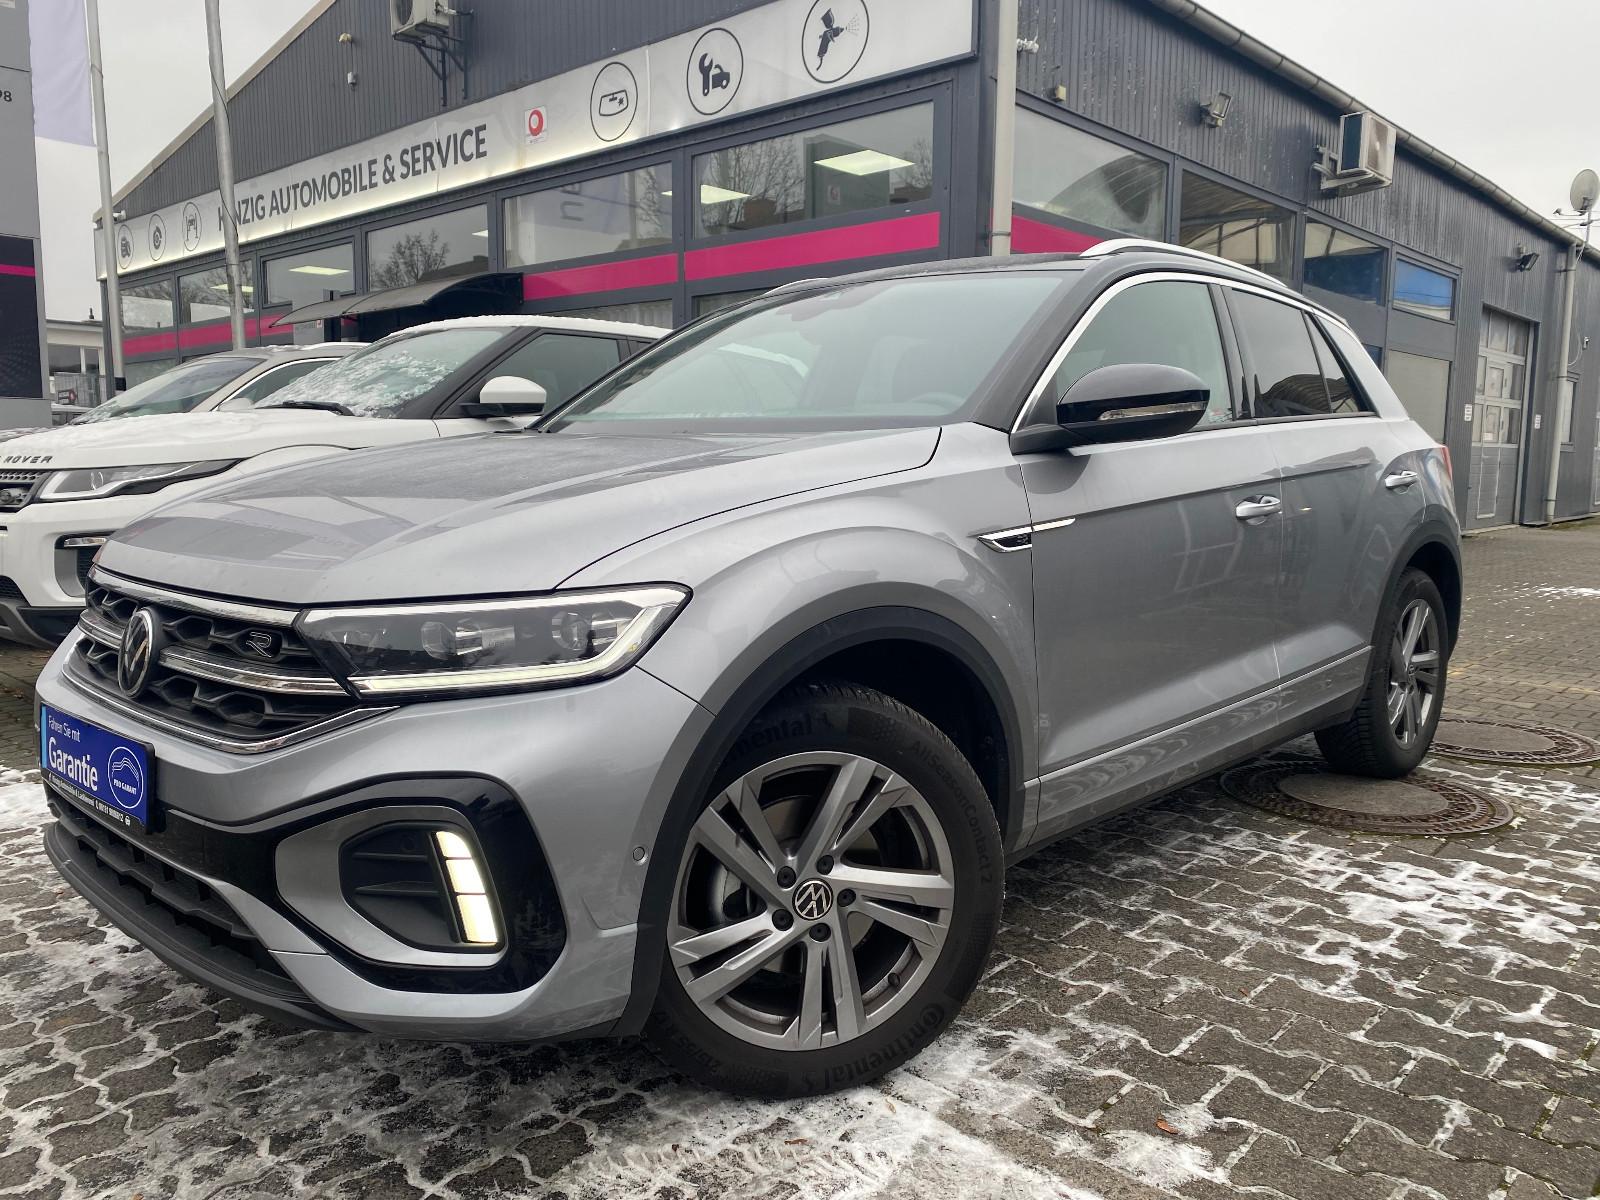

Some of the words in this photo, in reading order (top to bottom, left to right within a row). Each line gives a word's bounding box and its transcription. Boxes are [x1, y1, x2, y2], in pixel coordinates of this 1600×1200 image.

[0, 90, 12, 102] 8
[269, 158, 378, 218] AUTOMOBILE
[382, 154, 396, 184] &
[399, 123, 488, 180] SERVICE
[3, 455, 53, 464] ROVER
[246, 631, 272, 658] R
[48, 715, 63, 735] Fahren
[63, 722, 71, 739] Sie
[71, 729, 81, 743] mit
[48, 736, 98, 792] Garantie
[824, 1002, 946, 1090] Continental
